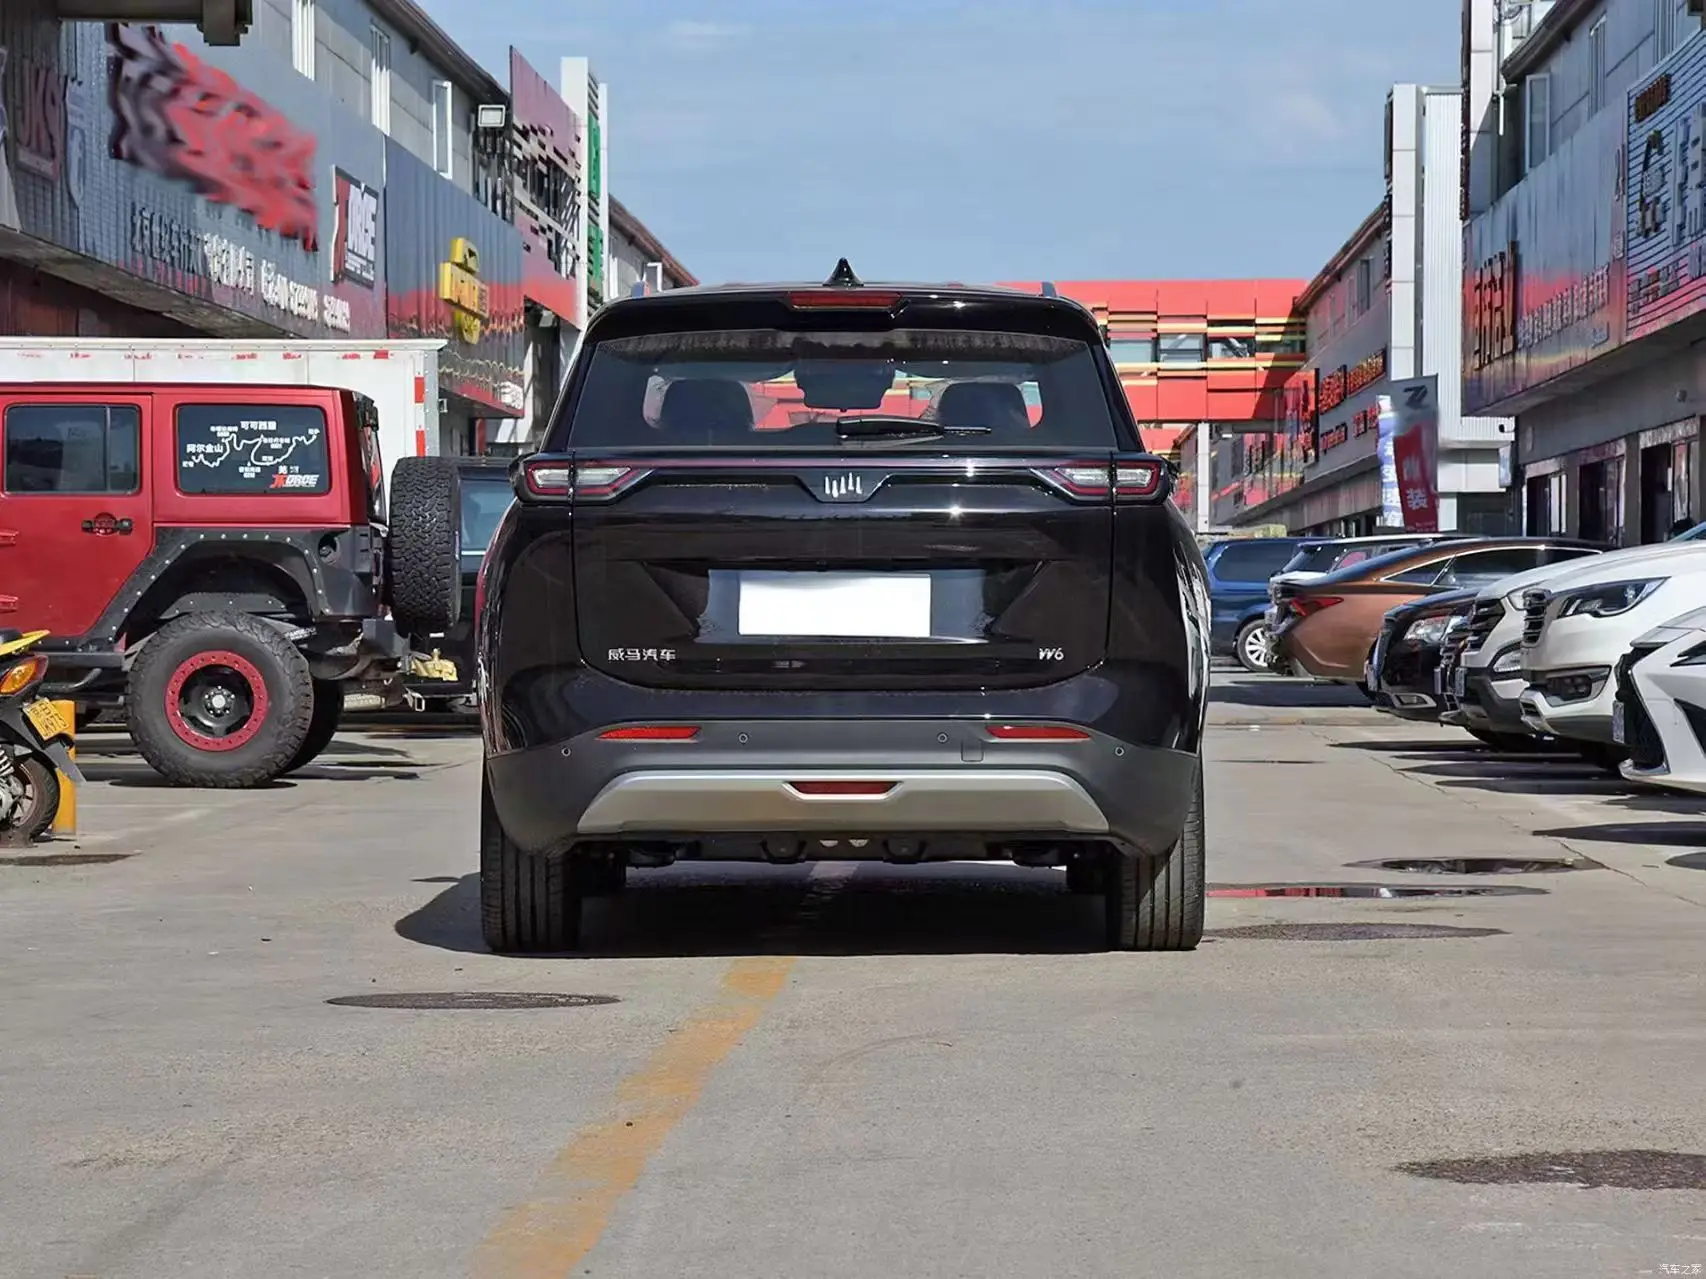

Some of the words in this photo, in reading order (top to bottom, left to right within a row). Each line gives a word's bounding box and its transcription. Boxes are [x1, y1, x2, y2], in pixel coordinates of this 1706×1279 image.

[608, 648, 676, 661] 威马汽车
[1039, 647, 1064, 661] W6
